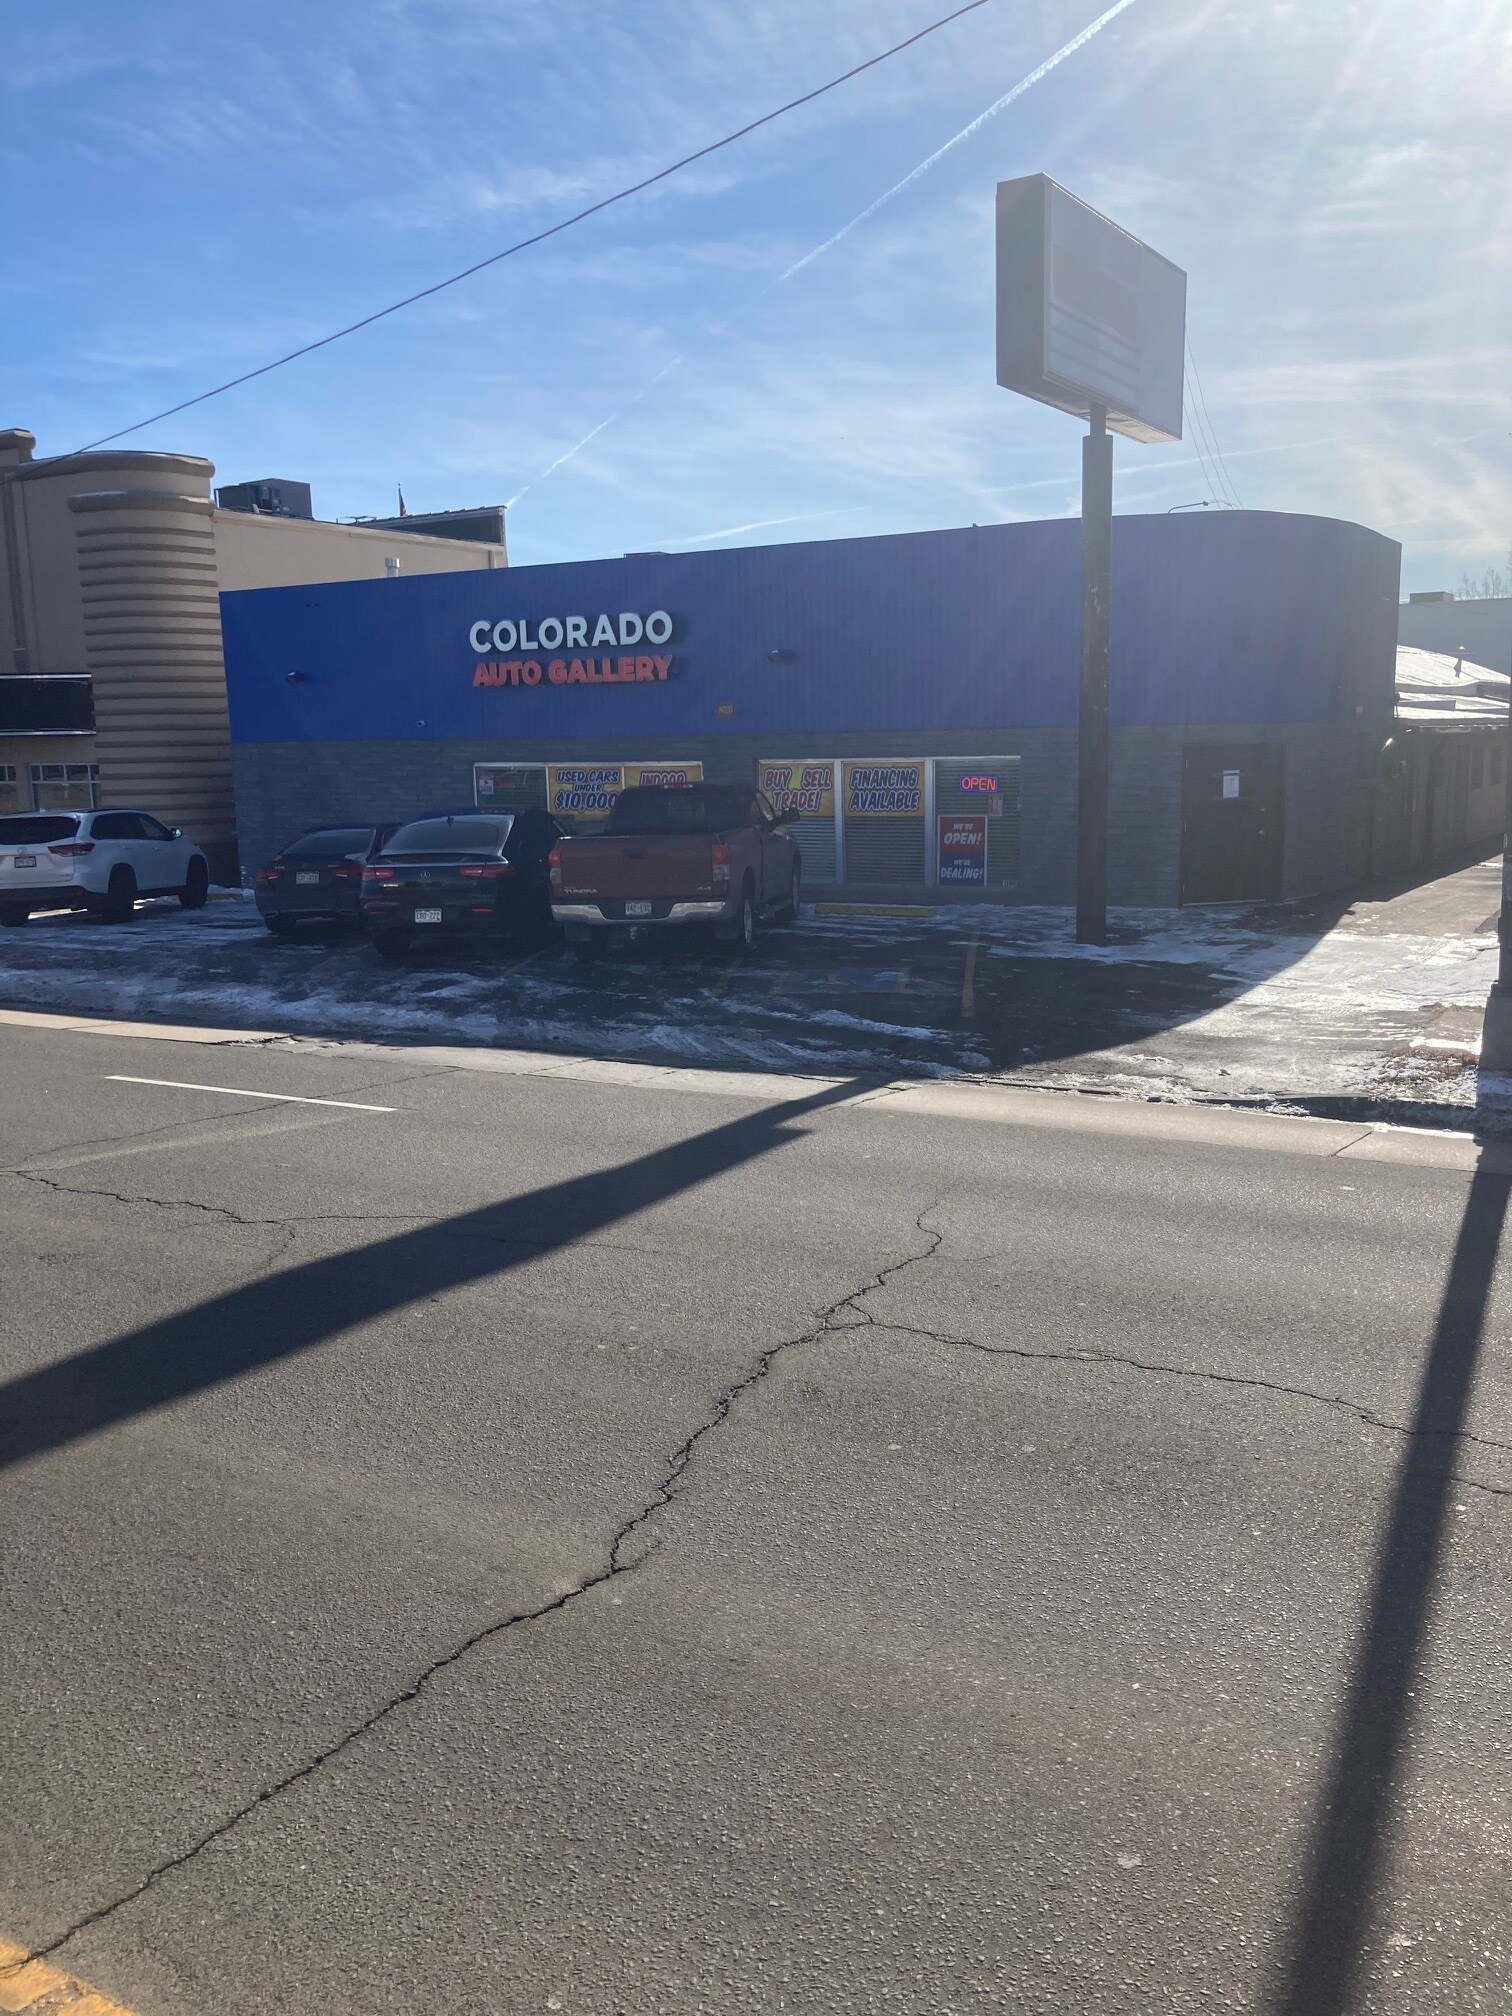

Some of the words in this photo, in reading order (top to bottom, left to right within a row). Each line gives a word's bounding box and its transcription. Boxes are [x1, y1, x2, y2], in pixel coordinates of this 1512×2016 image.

[469, 610, 673, 653] COLORADO
[472, 660, 542, 687] AUTO
[548, 655, 673, 685] GALLERY
[557, 769, 586, 783] USED
[588, 769, 620, 783] CARS
[763, 768, 791, 789] BUY
[801, 768, 832, 789] SELL
[850, 767, 918, 789] FINANCING
[961, 777, 996, 791] OPEN
[574, 783, 603, 792] UNDER
[773, 790, 822, 811] TRADE!
[849, 790, 919, 811] AVAILABLE
[953, 823, 973, 831] WE'RE
[943, 832, 982, 845] OPEN!
[940, 867, 983, 880] DEALING!
